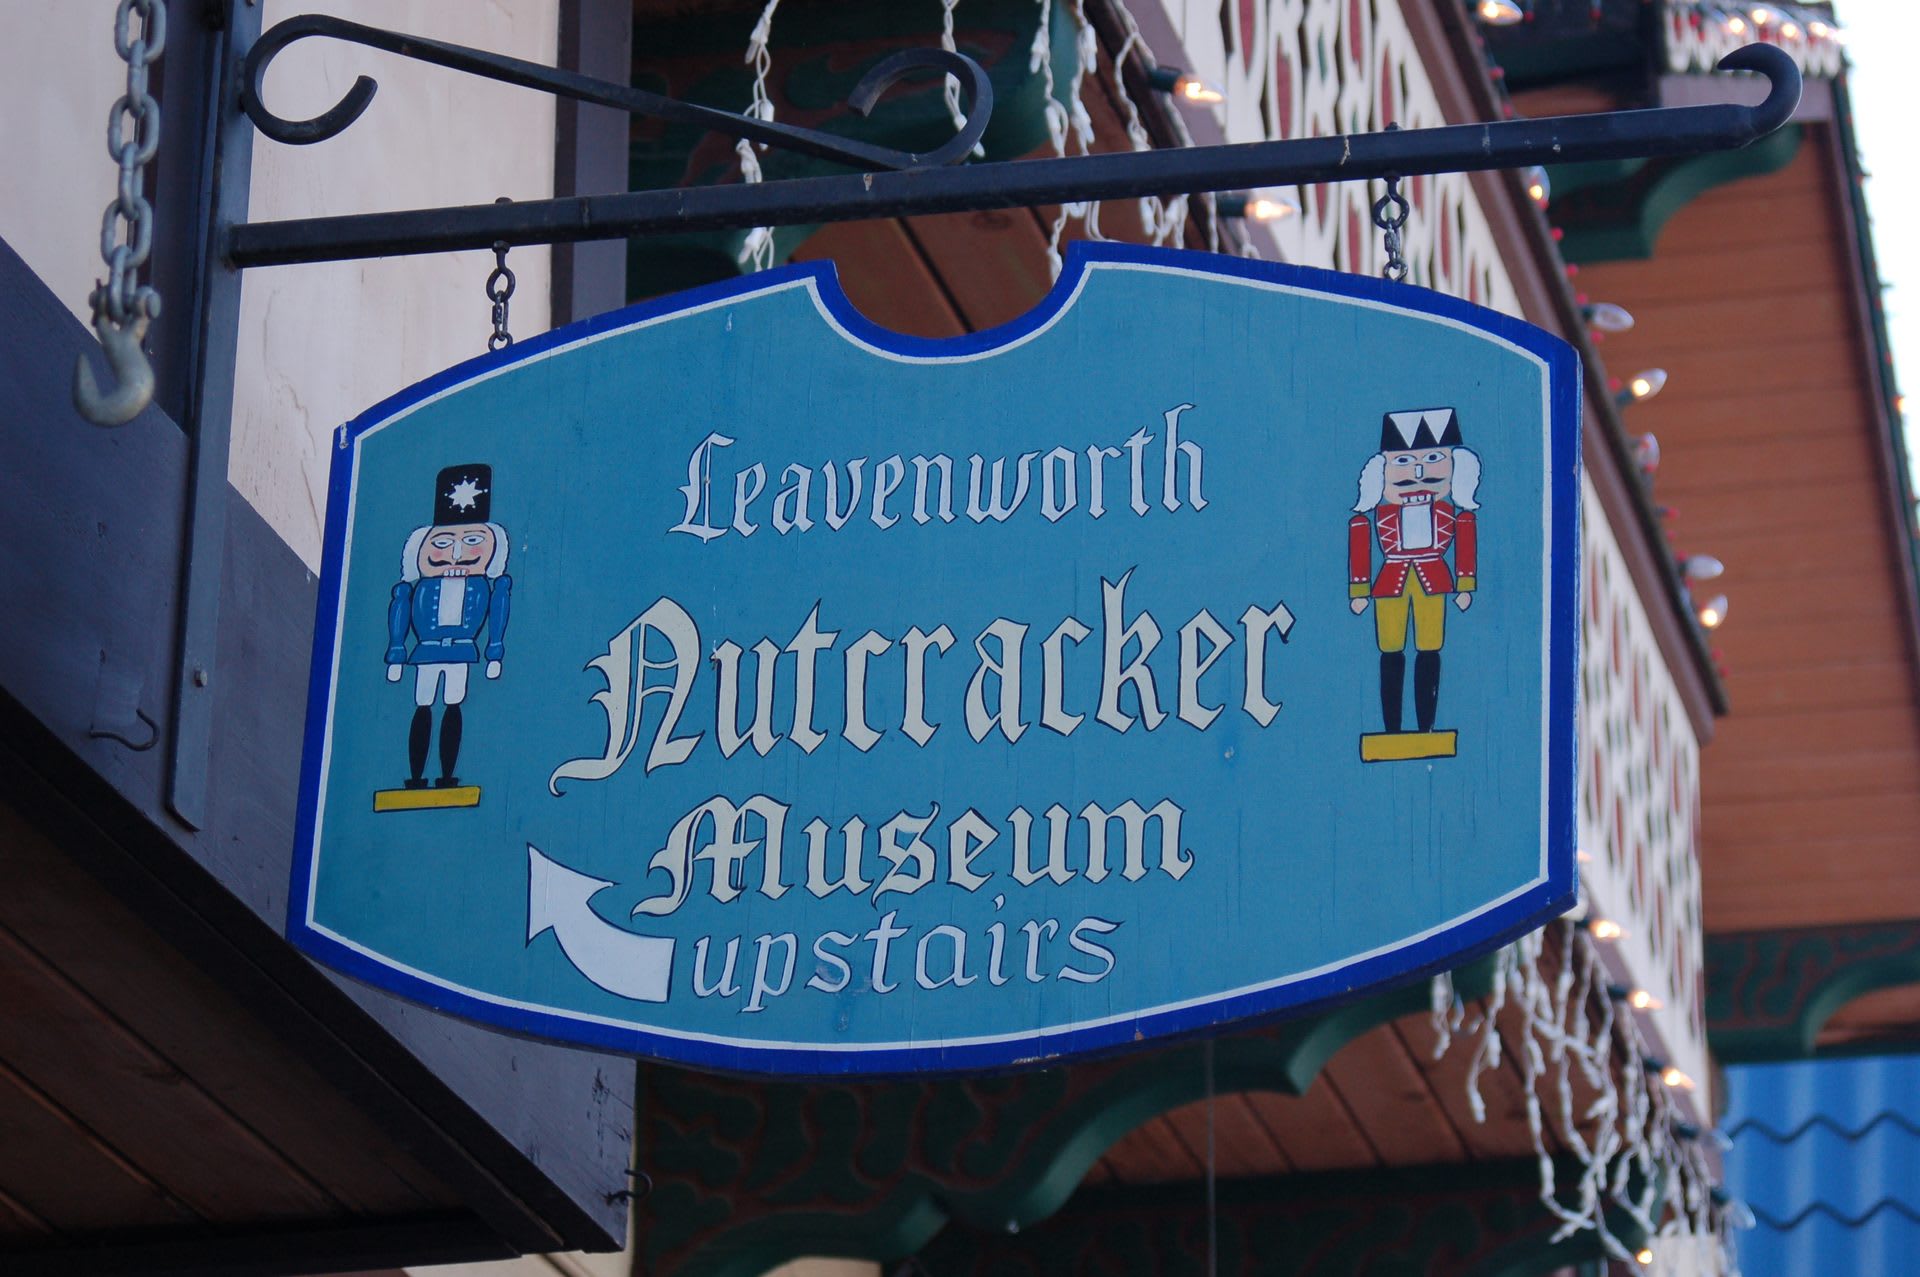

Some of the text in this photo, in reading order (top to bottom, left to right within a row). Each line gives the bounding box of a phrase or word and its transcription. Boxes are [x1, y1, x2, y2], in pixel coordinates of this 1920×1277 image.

[668, 403, 1209, 545] Leavenworth
[549, 565, 1294, 798] Nutcracker
[632, 794, 1194, 917] Museum
[693, 895, 1123, 1014] upstairs
